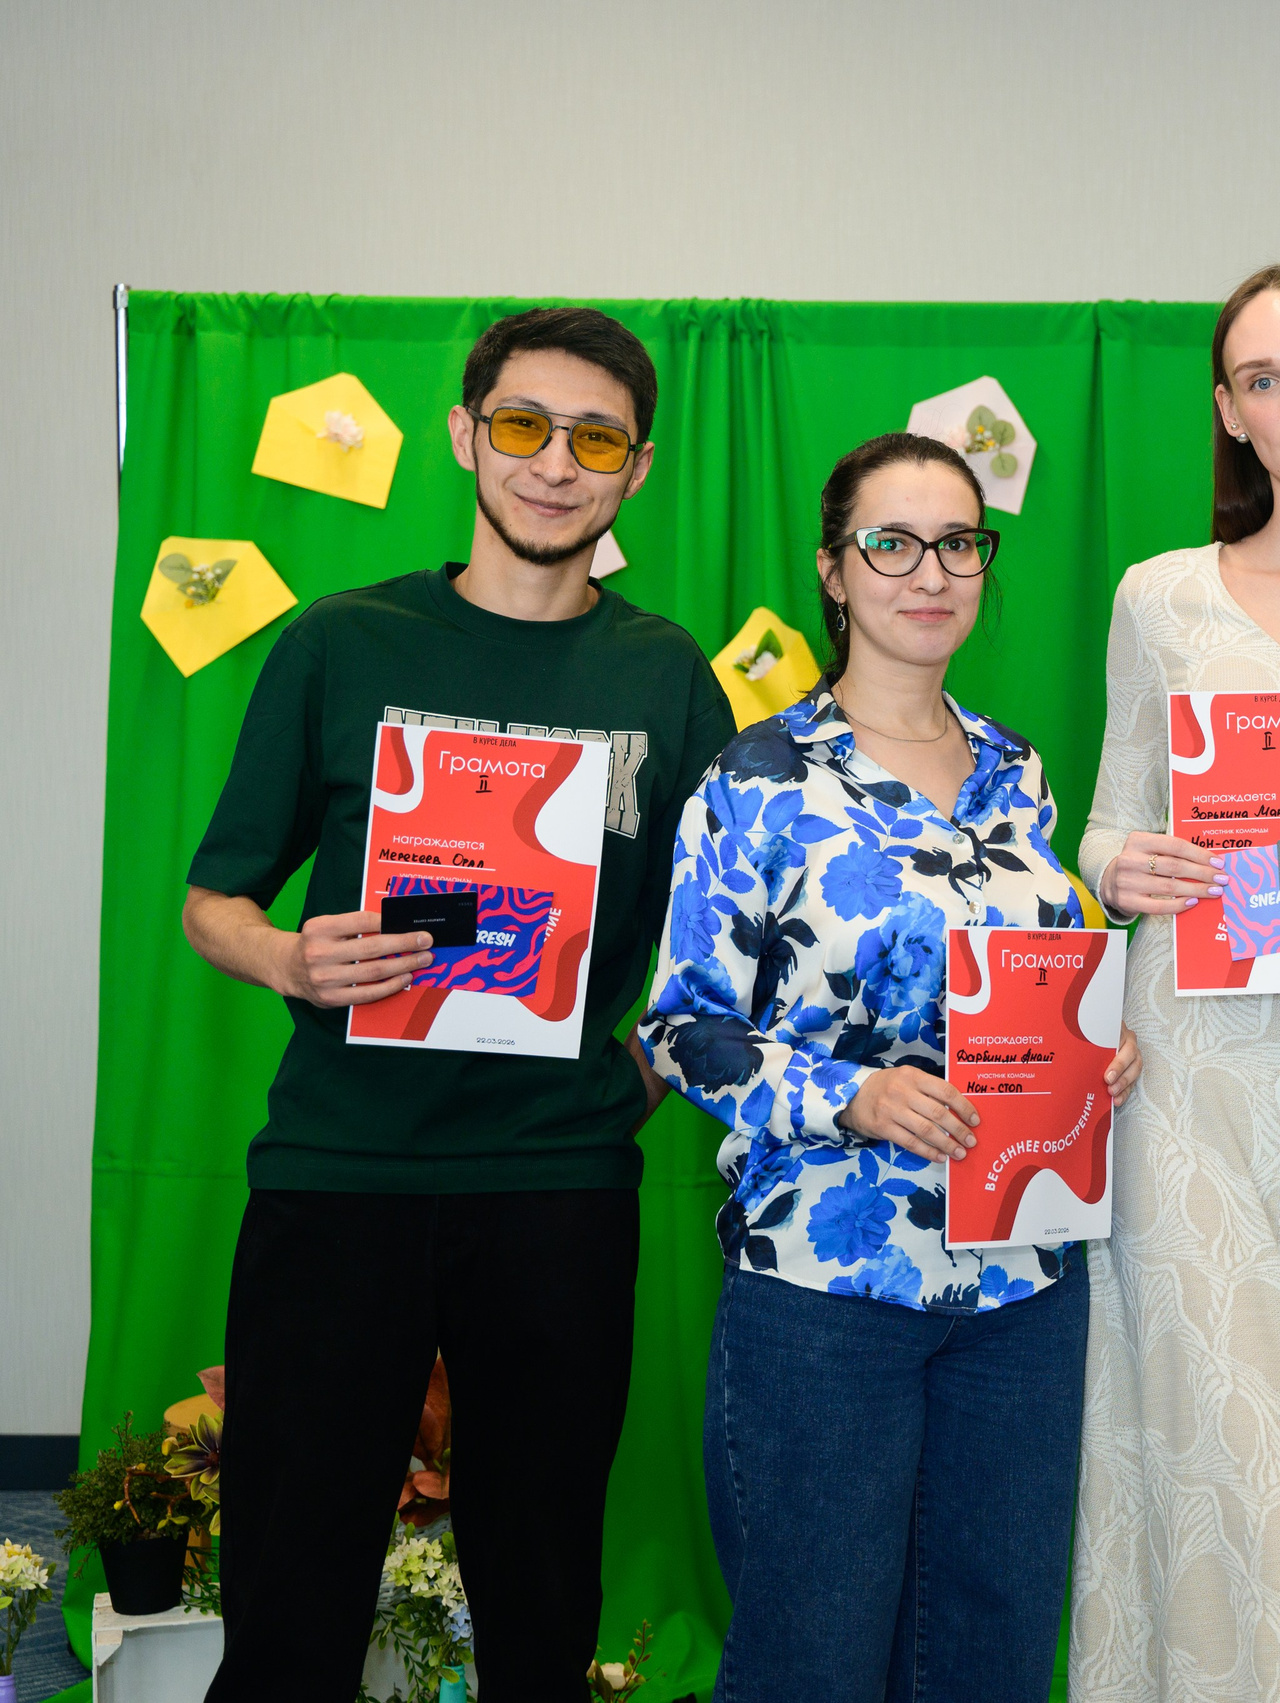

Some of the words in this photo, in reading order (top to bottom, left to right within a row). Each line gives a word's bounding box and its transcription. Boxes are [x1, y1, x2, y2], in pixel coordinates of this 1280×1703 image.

[1260, 695, 1277, 703] КУРСЕ
[479, 737, 498, 746] КУРСЕ
[499, 739, 517, 747] ДЕЛА
[439, 750, 546, 779] Грамота
[1192, 793, 1276, 804] награждается
[1191, 806, 1248, 819] Зорькина
[1202, 828, 1234, 836] участник
[392, 835, 485, 850] награждается
[476, 929, 516, 947] RESH
[1032, 933, 1047, 941] КУРСЕ
[1002, 950, 1084, 973] Грамота
[476, 1037, 515, 1045] 22.03.2026
[968, 1036, 1043, 1046] награждается
[984, 1139, 1040, 1191] ВЕСЕННЕЕ
[1042, 1092, 1095, 1154] ОБОСТРЕНИЕ
